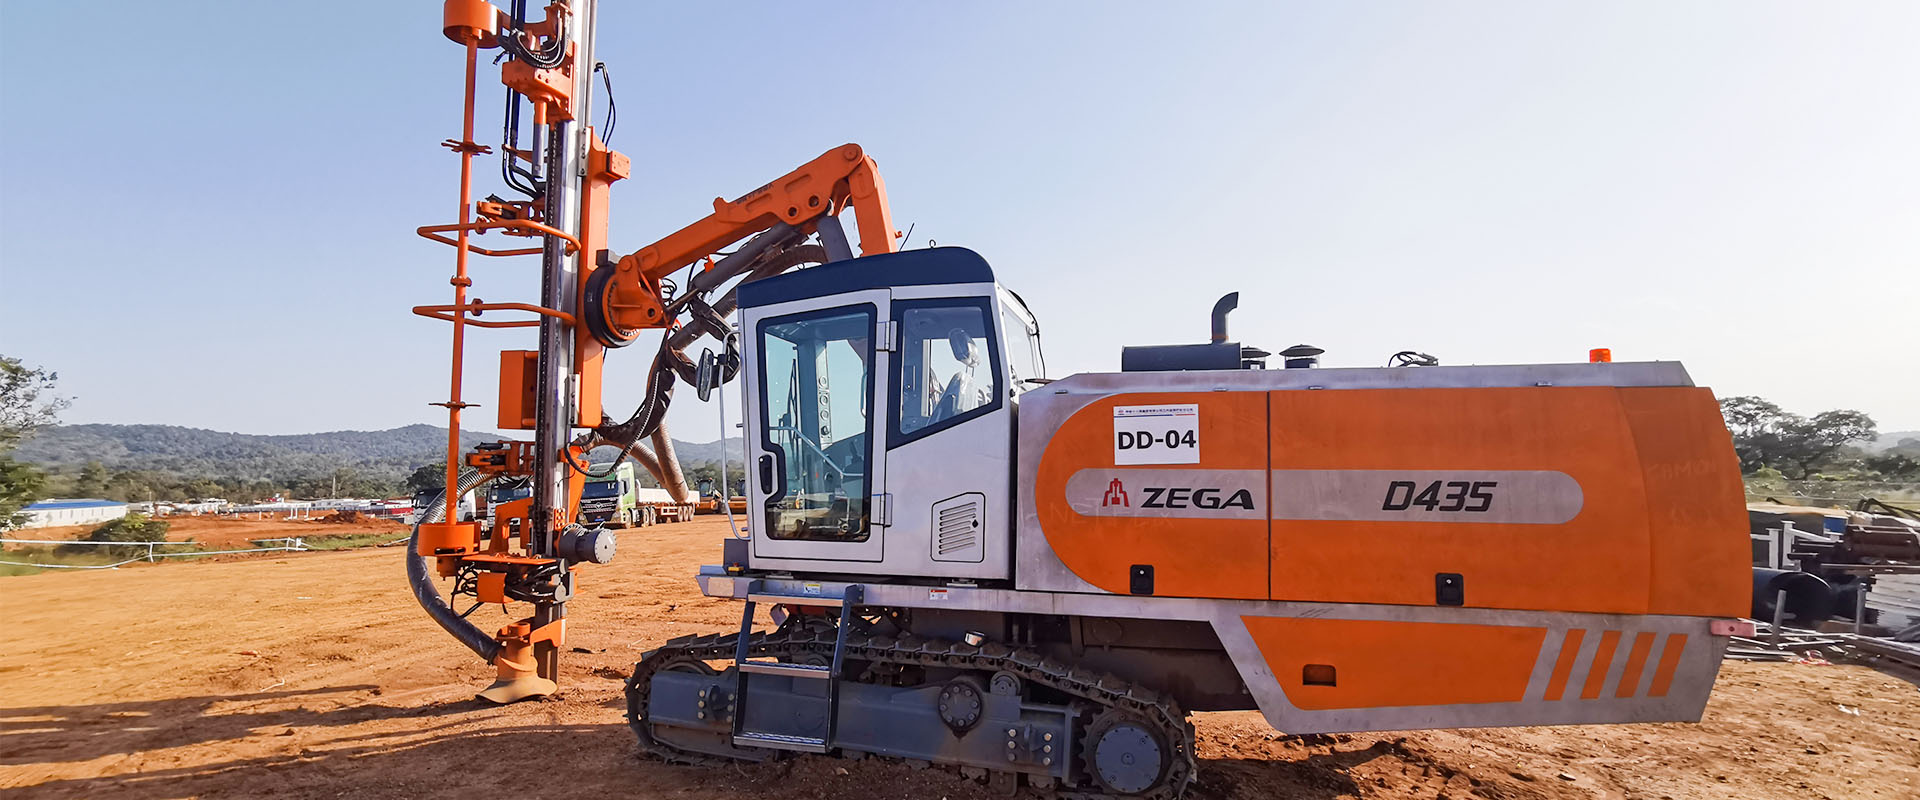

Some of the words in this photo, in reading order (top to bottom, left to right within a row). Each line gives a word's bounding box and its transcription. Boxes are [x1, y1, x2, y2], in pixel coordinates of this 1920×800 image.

[1118, 430, 1196, 450] DD-04
[1140, 487, 1255, 510] ZEGA
[1382, 480, 1498, 512] D435
